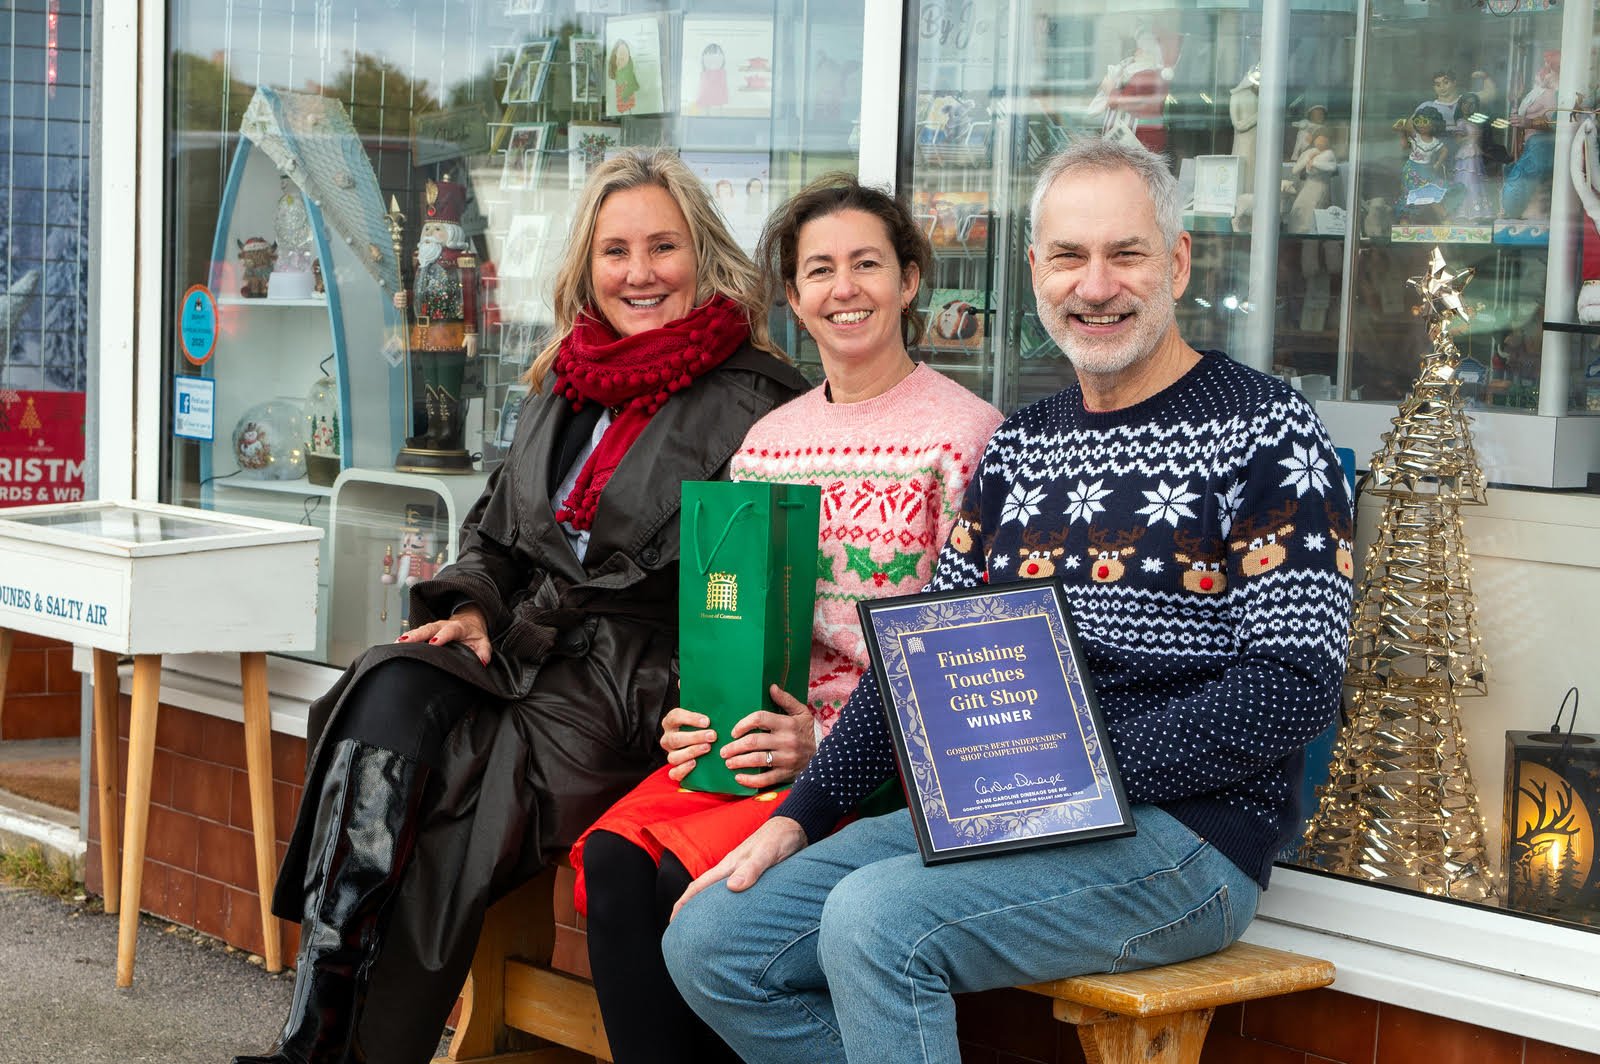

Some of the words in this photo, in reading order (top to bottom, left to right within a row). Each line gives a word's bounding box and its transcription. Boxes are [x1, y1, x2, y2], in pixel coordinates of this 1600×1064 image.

[0, 486, 33, 501] RDS
[36, 487, 48, 502] &
[53, 488, 85, 503] WR
[34, 592, 43, 613] &
[46, 595, 83, 621] SALTY
[86, 603, 108, 626] AIR
[936, 644, 1027, 668] Finishing
[944, 668, 1025, 689] Touches
[950, 693, 988, 712] Gift
[990, 688, 1039, 706] Shop
[966, 709, 1032, 729] WINNER
[946, 744, 990, 756] GOSPORT'S
[990, 740, 1010, 750] BEST
[1011, 732, 1067, 746] INDEPENDENT
[960, 752, 982, 762] SHOP
[983, 744, 1039, 759] COMPETITION
[1039, 741, 1058, 751] 2025
[975, 797, 992, 805] DAME
[992, 793, 1020, 802] CAROLINE
[1020, 789, 1047, 799] DINENAGE
